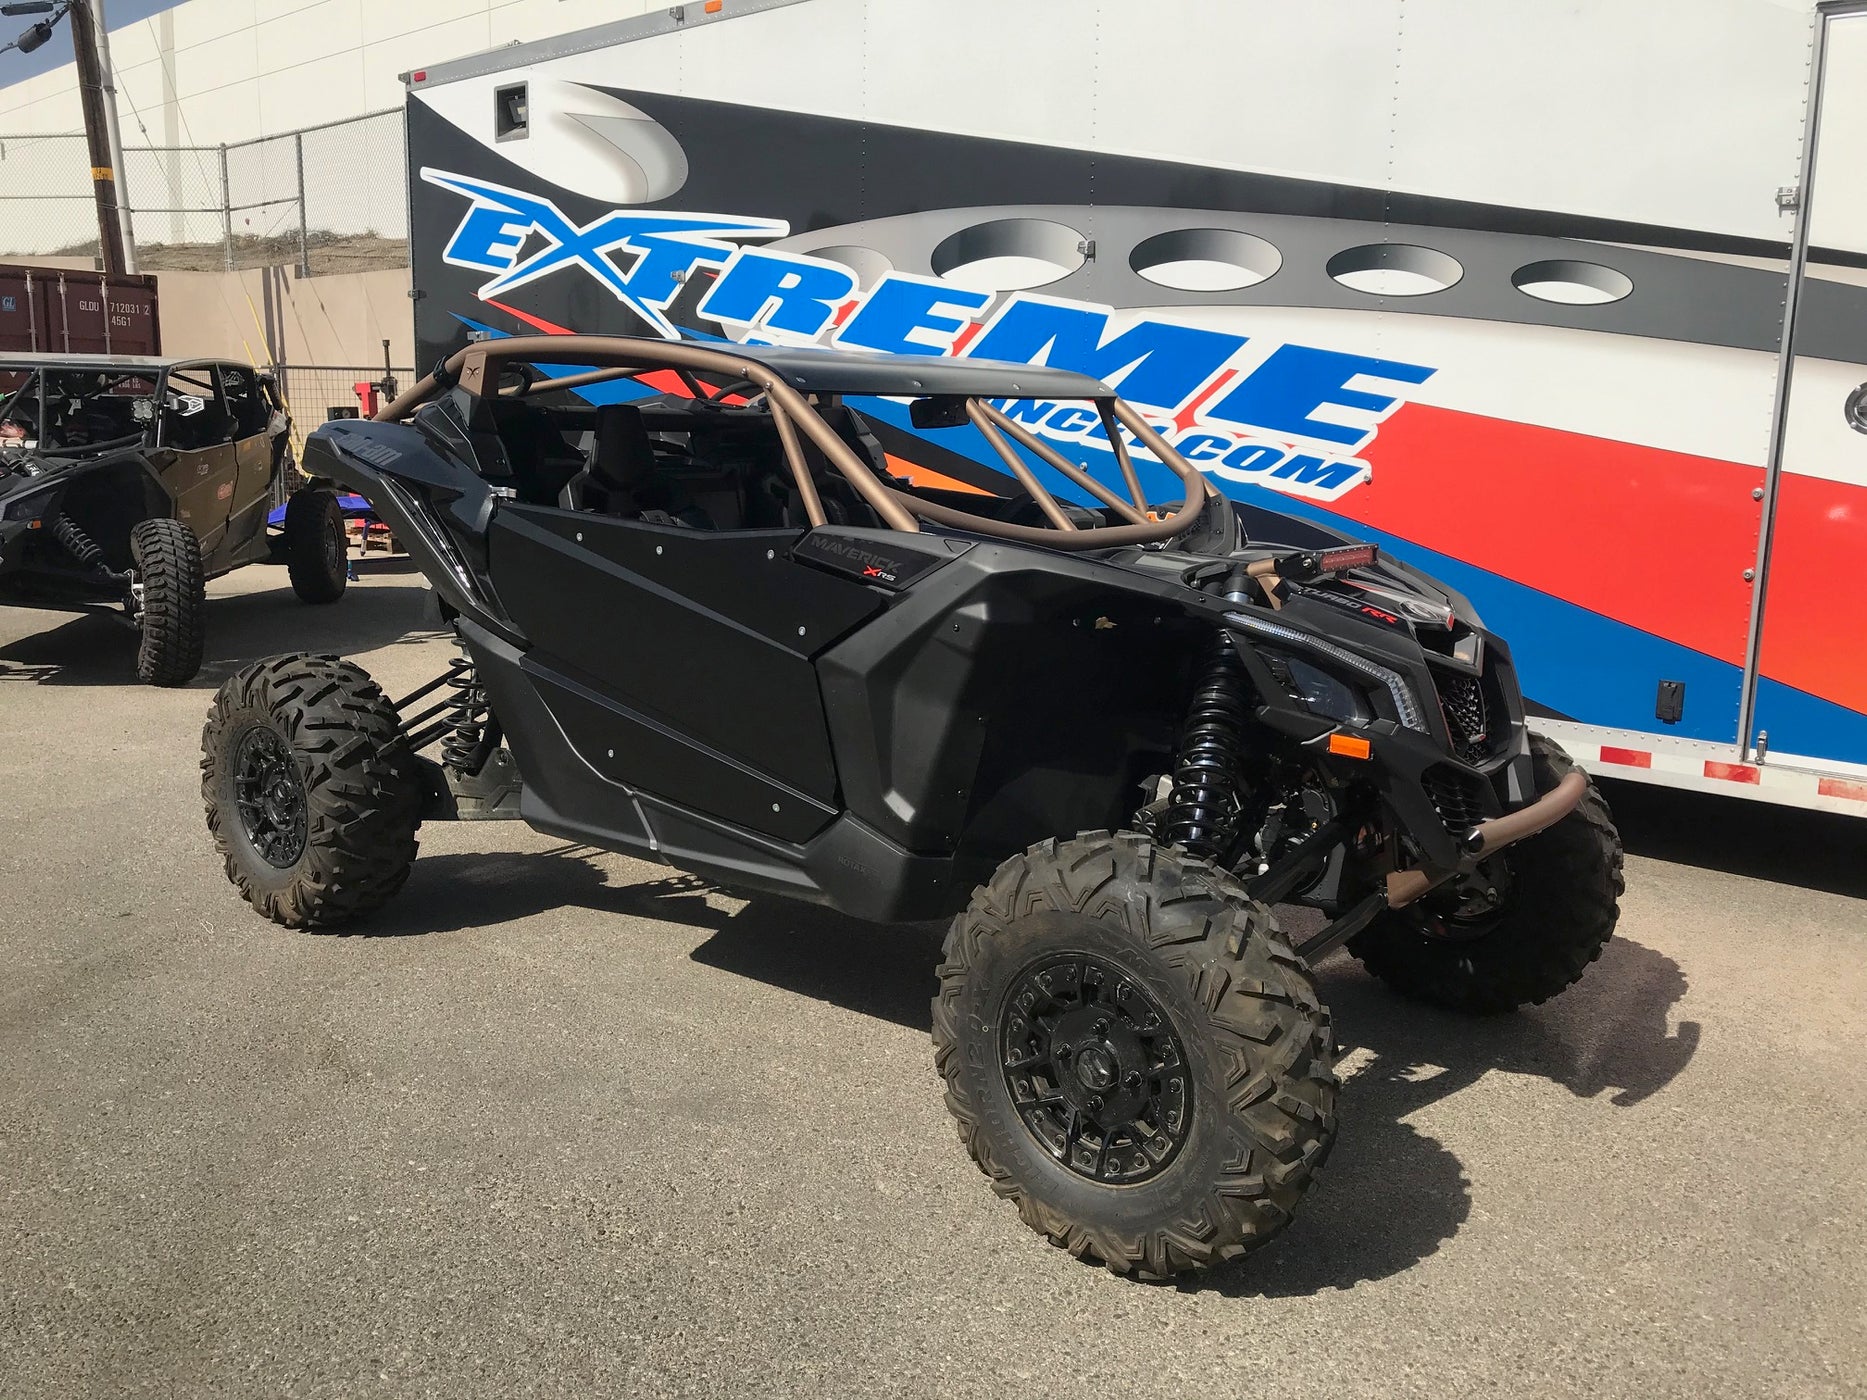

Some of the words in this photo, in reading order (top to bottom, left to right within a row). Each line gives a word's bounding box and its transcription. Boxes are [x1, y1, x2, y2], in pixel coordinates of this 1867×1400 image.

[79, 300, 100, 312] GLDU
[110, 302, 140, 315] 712031
[143, 304, 151, 316] 2
[420, 166, 1438, 446] EXTREME
[111, 315, 131, 327] 45G1
[811, 536, 902, 574] MAVERICK
[1360, 606, 1398, 624] RR
